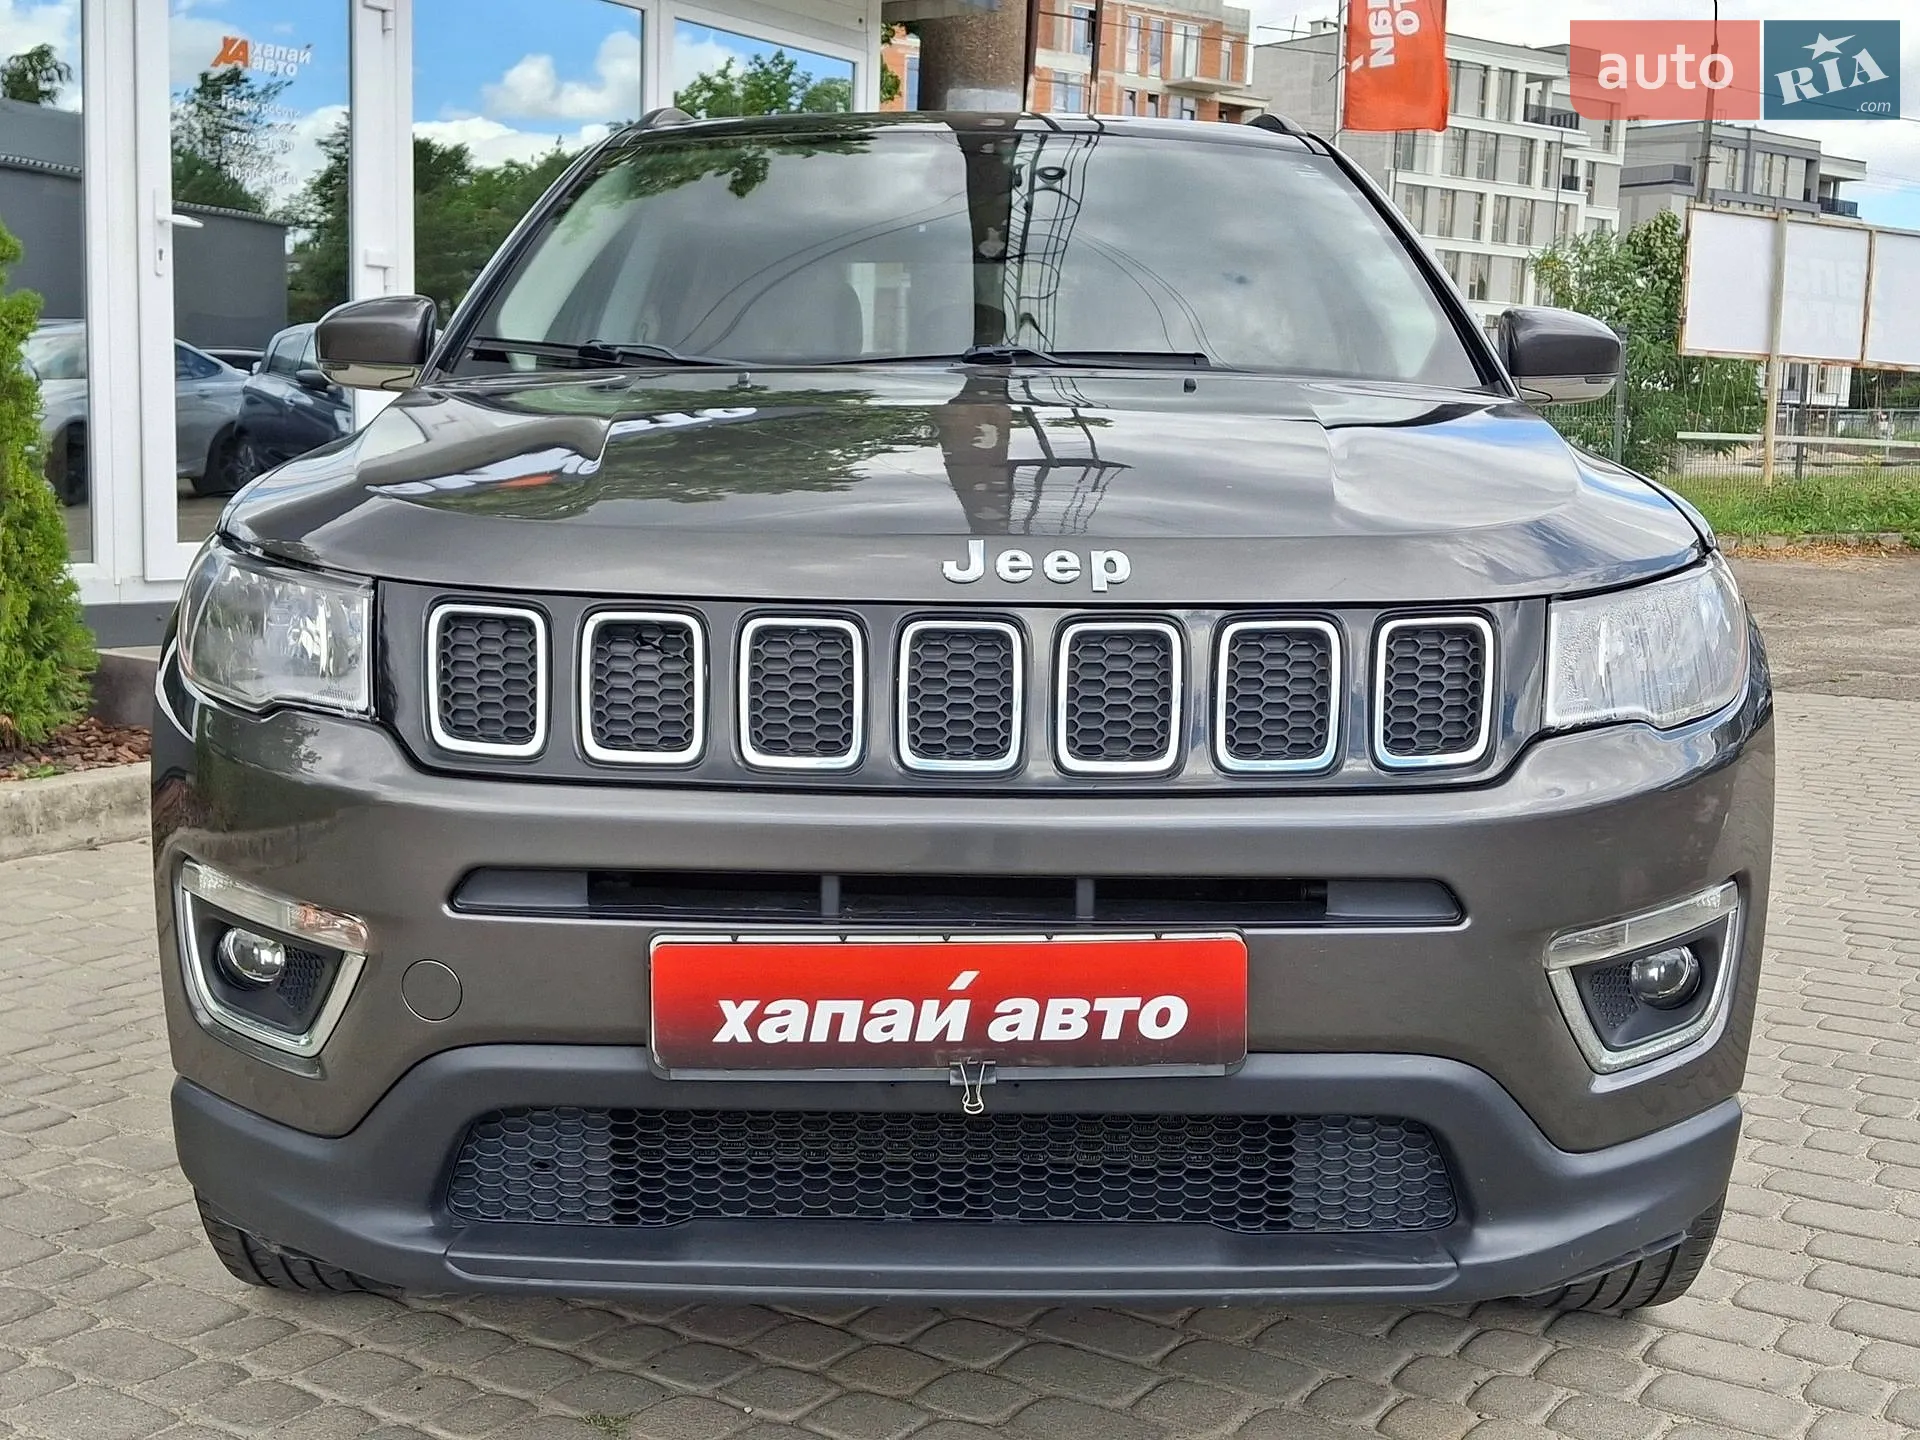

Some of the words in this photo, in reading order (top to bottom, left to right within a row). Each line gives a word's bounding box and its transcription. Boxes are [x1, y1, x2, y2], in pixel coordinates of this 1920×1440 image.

[252, 41, 314, 64] хапай
[252, 57, 298, 77] авто
[942, 539, 1131, 592] Jeep
[712, 970, 980, 1044] хапай
[987, 995, 1189, 1041] авто
